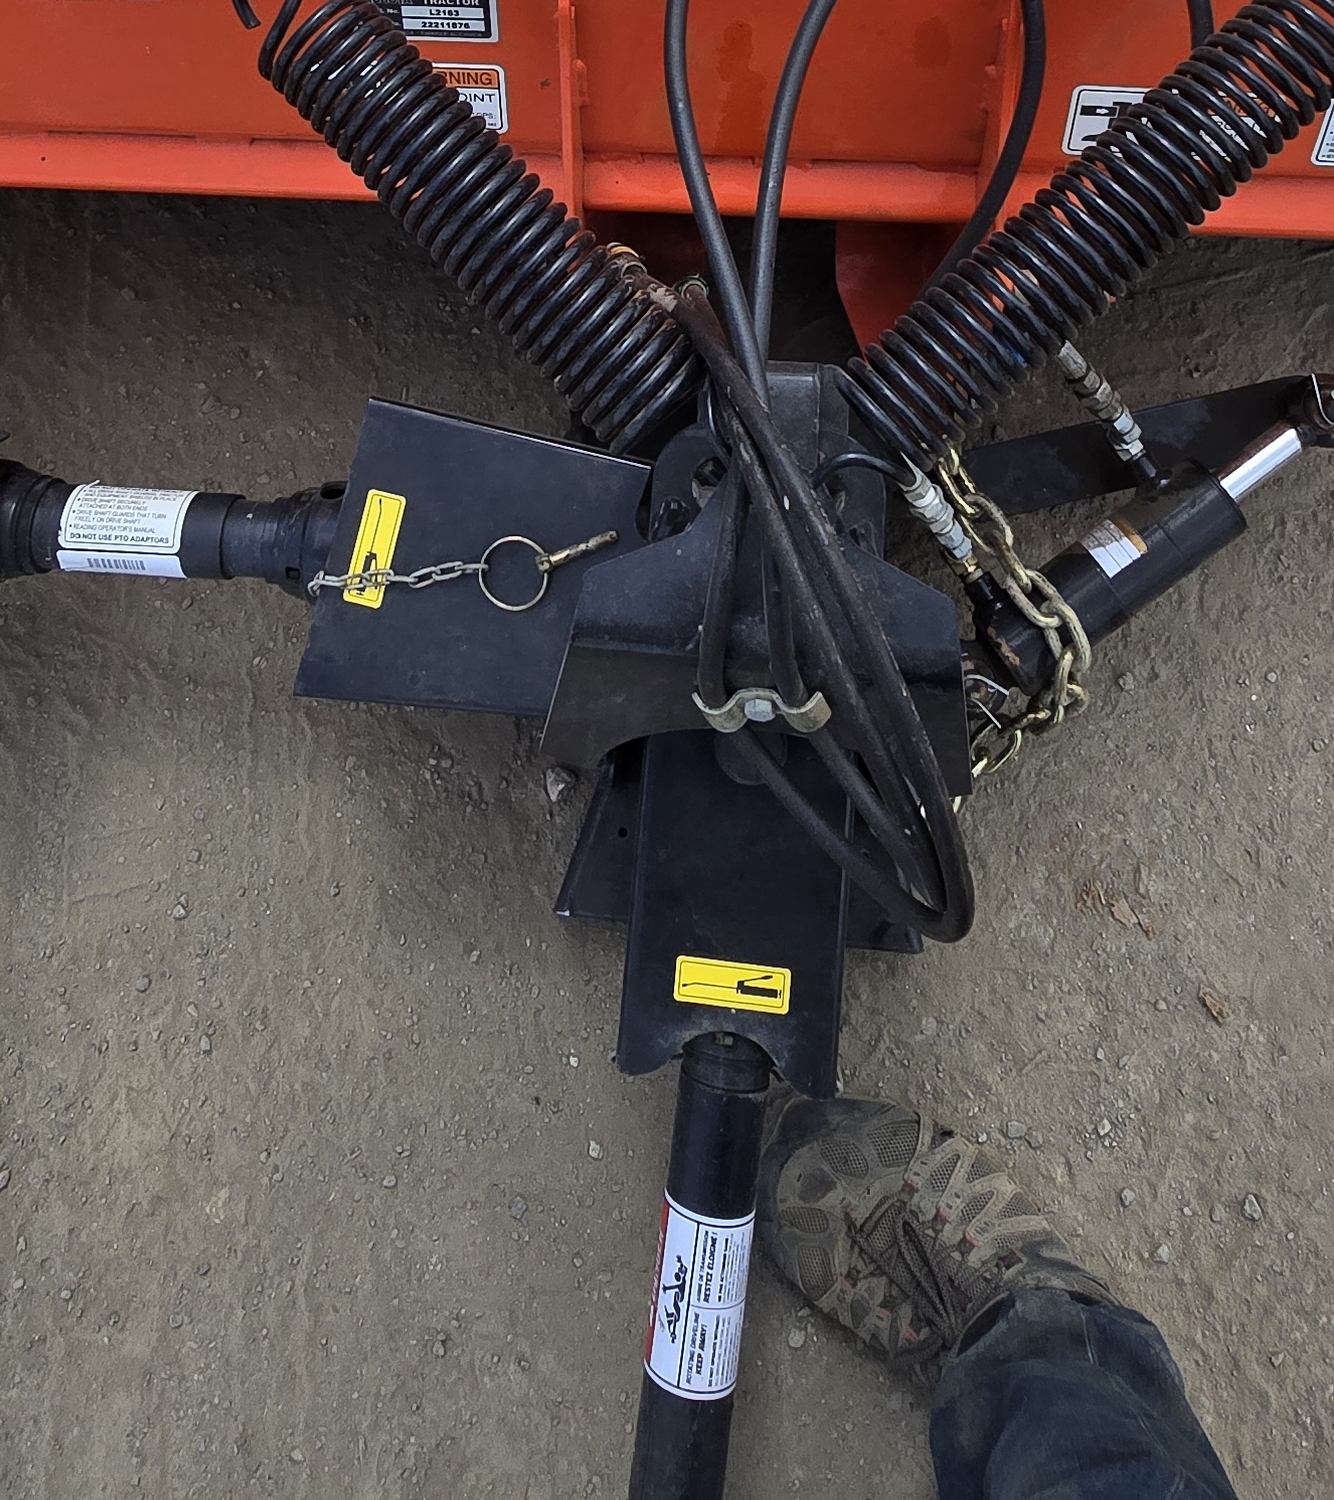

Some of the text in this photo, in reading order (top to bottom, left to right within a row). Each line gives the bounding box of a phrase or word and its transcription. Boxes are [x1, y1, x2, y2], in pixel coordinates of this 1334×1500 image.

[437, 72, 492, 85] NING
[130, 536, 169, 544] ADAPTORS
[703, 1272, 713, 1303] RESTEZ
[695, 1353, 703, 1375] KEEP
